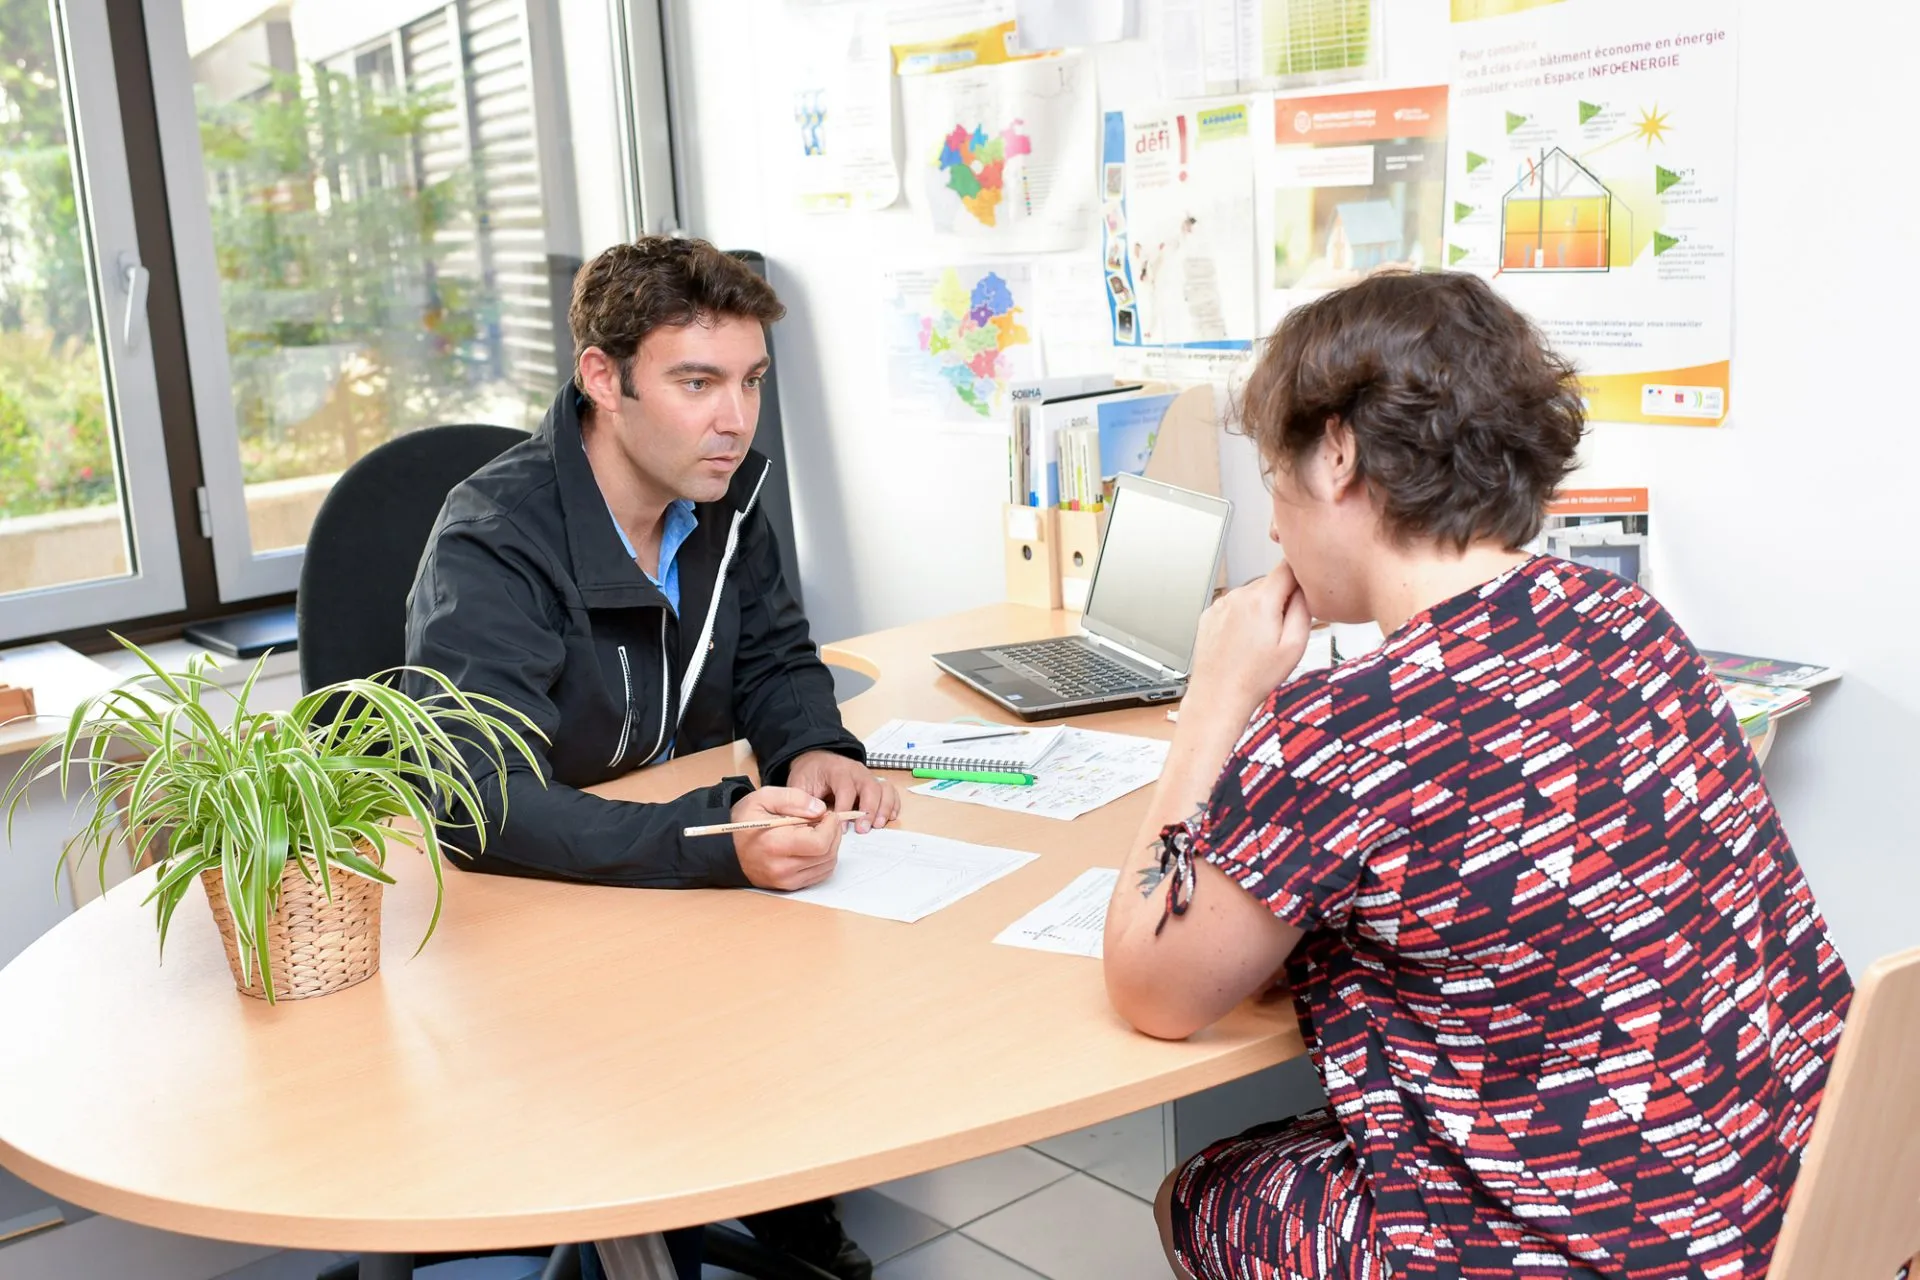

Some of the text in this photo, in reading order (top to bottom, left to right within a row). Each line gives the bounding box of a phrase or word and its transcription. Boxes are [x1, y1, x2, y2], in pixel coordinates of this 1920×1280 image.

[1460, 49, 1484, 60] Pour
[1481, 65, 1488, 76] 8
[1490, 63, 1511, 75] clés
[1540, 48, 1591, 67] bâtiment
[1594, 40, 1652, 59] économe
[1655, 38, 1671, 50] en
[1675, 28, 1726, 46] énergie
[1544, 70, 1585, 86] Espace
[1135, 130, 1170, 154] défi
